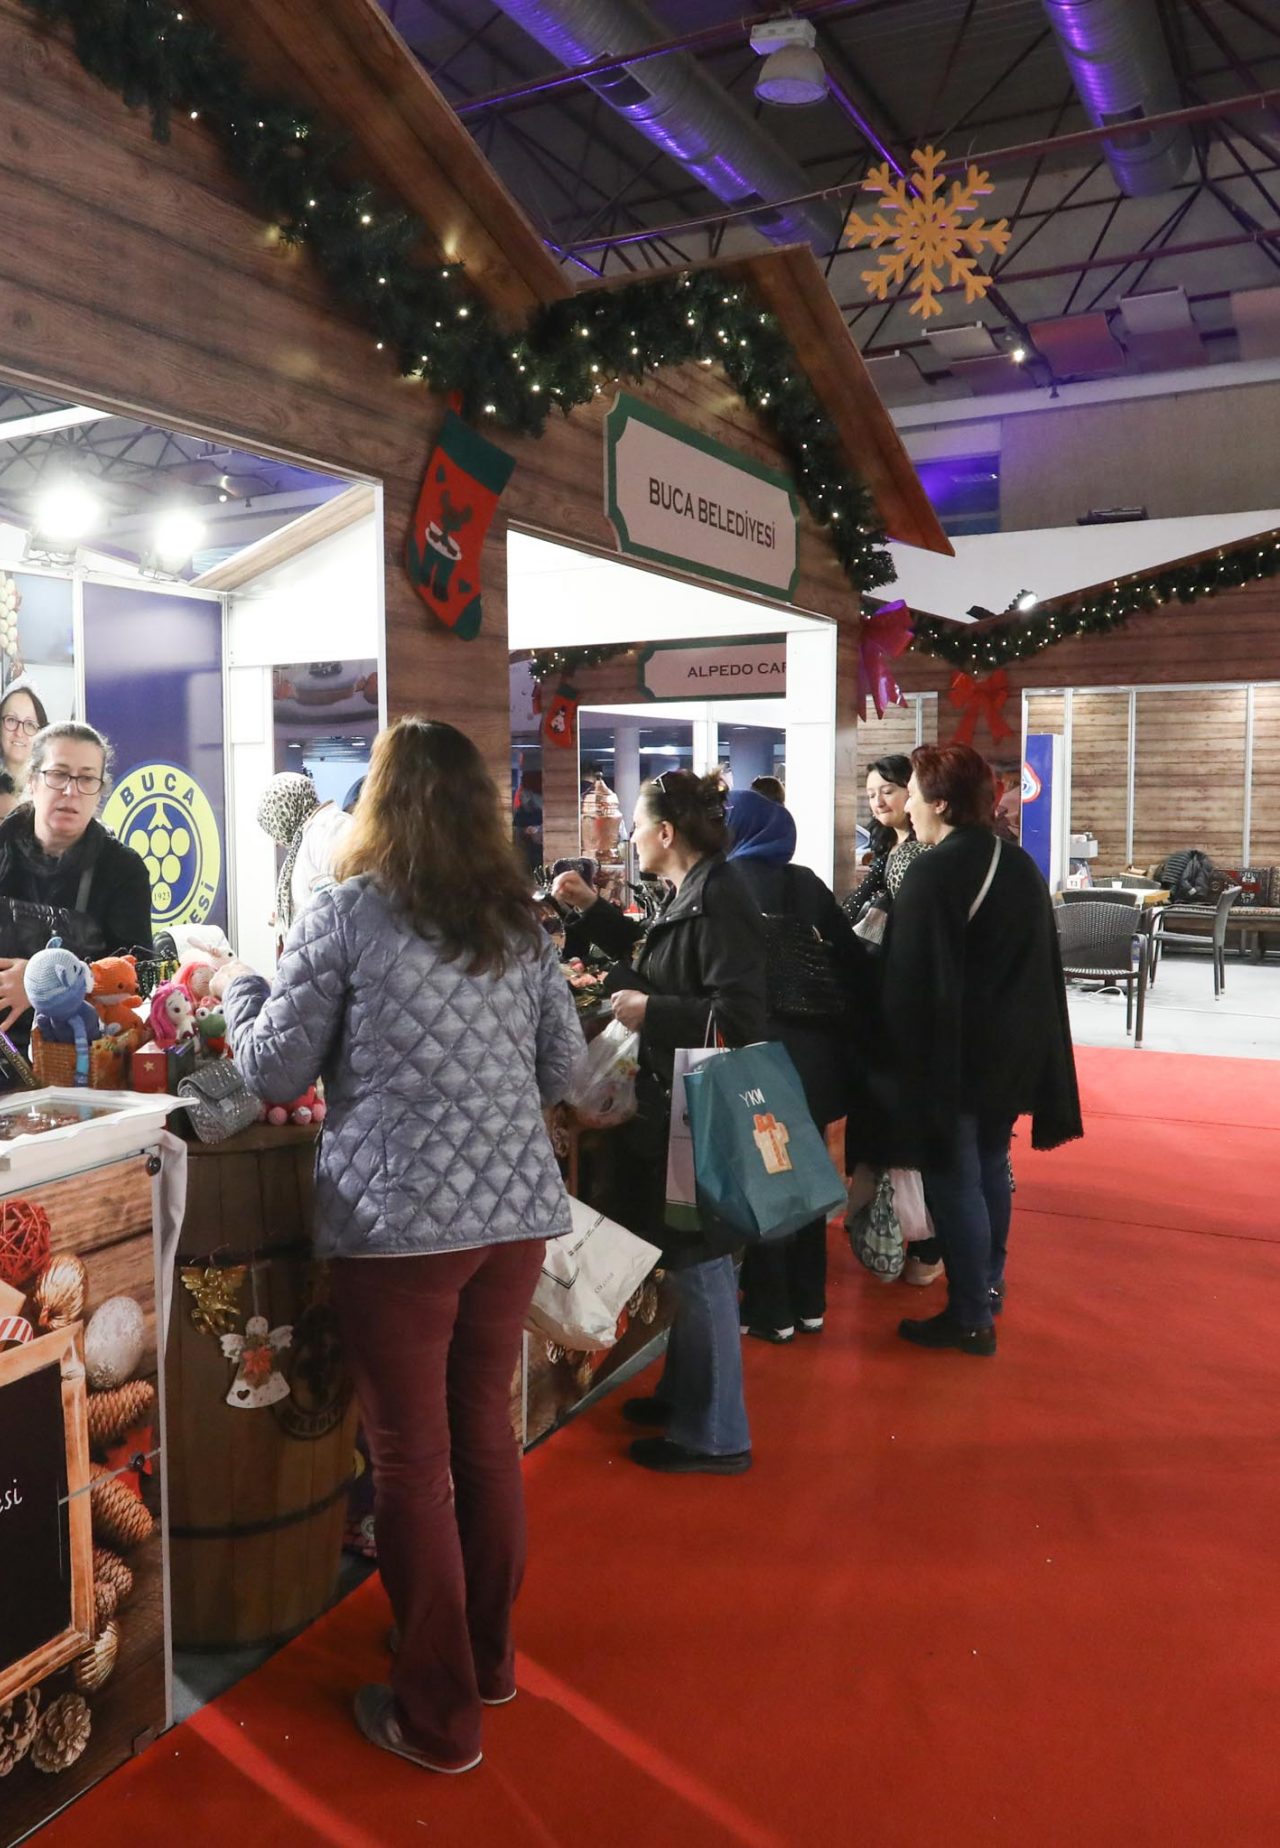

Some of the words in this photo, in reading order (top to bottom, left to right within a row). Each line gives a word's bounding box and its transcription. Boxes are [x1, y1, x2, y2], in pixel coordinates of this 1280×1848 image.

[649, 477, 695, 519] BUCA
[698, 497, 776, 550] BELEDİYESİ
[687, 663, 754, 678] ALPEDO
[119, 772, 195, 808] BUCA
[153, 891, 171, 901] 1923
